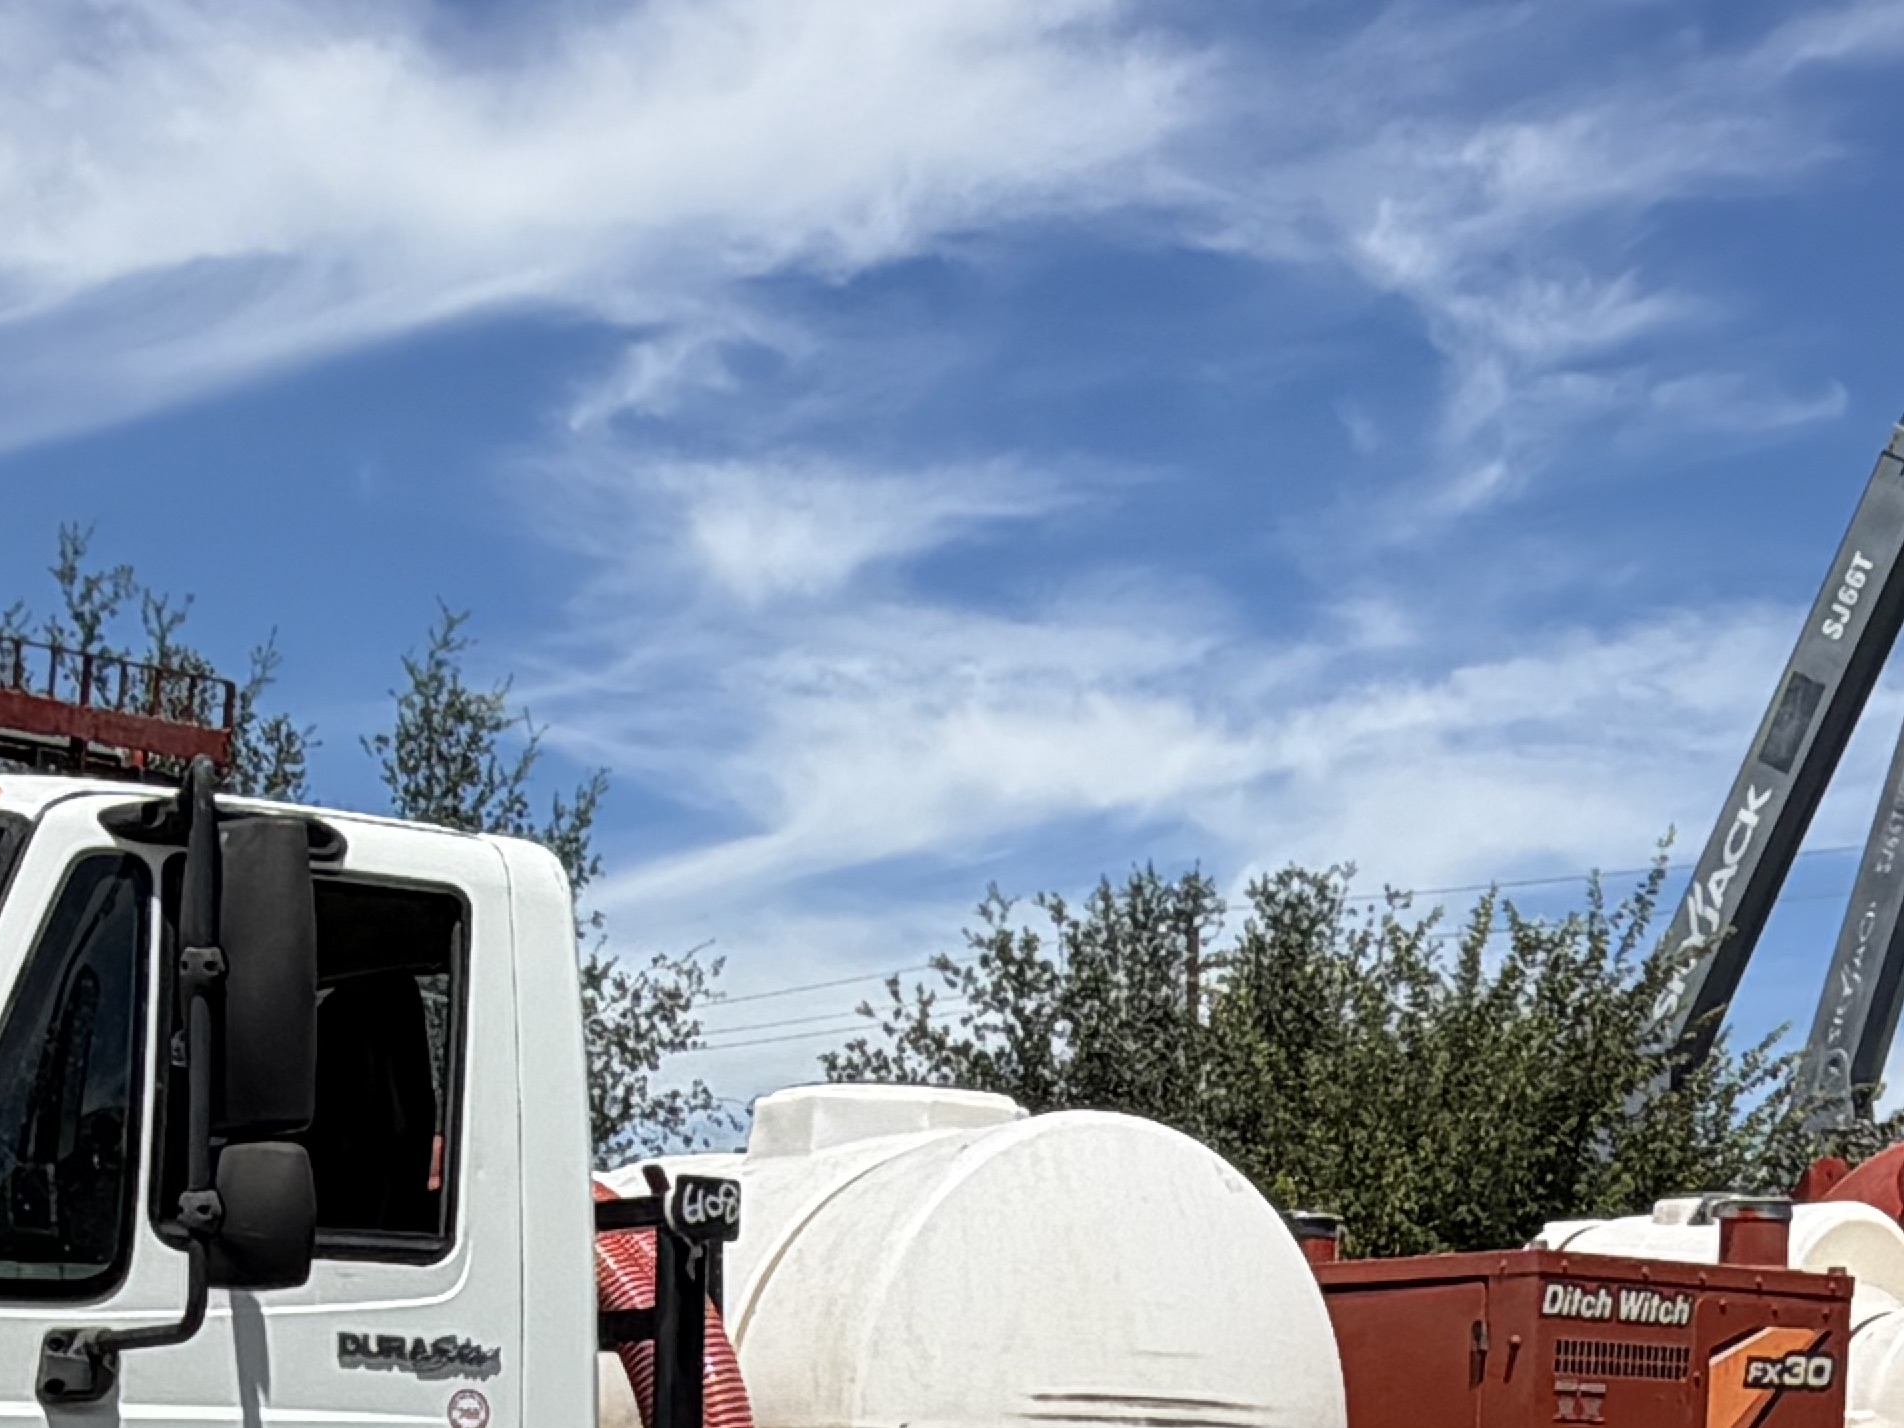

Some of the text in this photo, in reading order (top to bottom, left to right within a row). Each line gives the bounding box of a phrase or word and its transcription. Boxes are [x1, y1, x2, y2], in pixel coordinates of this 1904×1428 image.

[1821, 550, 1874, 641] SJ66T
[1542, 1283, 1691, 1326] Ditch Witch
[1746, 1355, 1833, 1387] FX30
